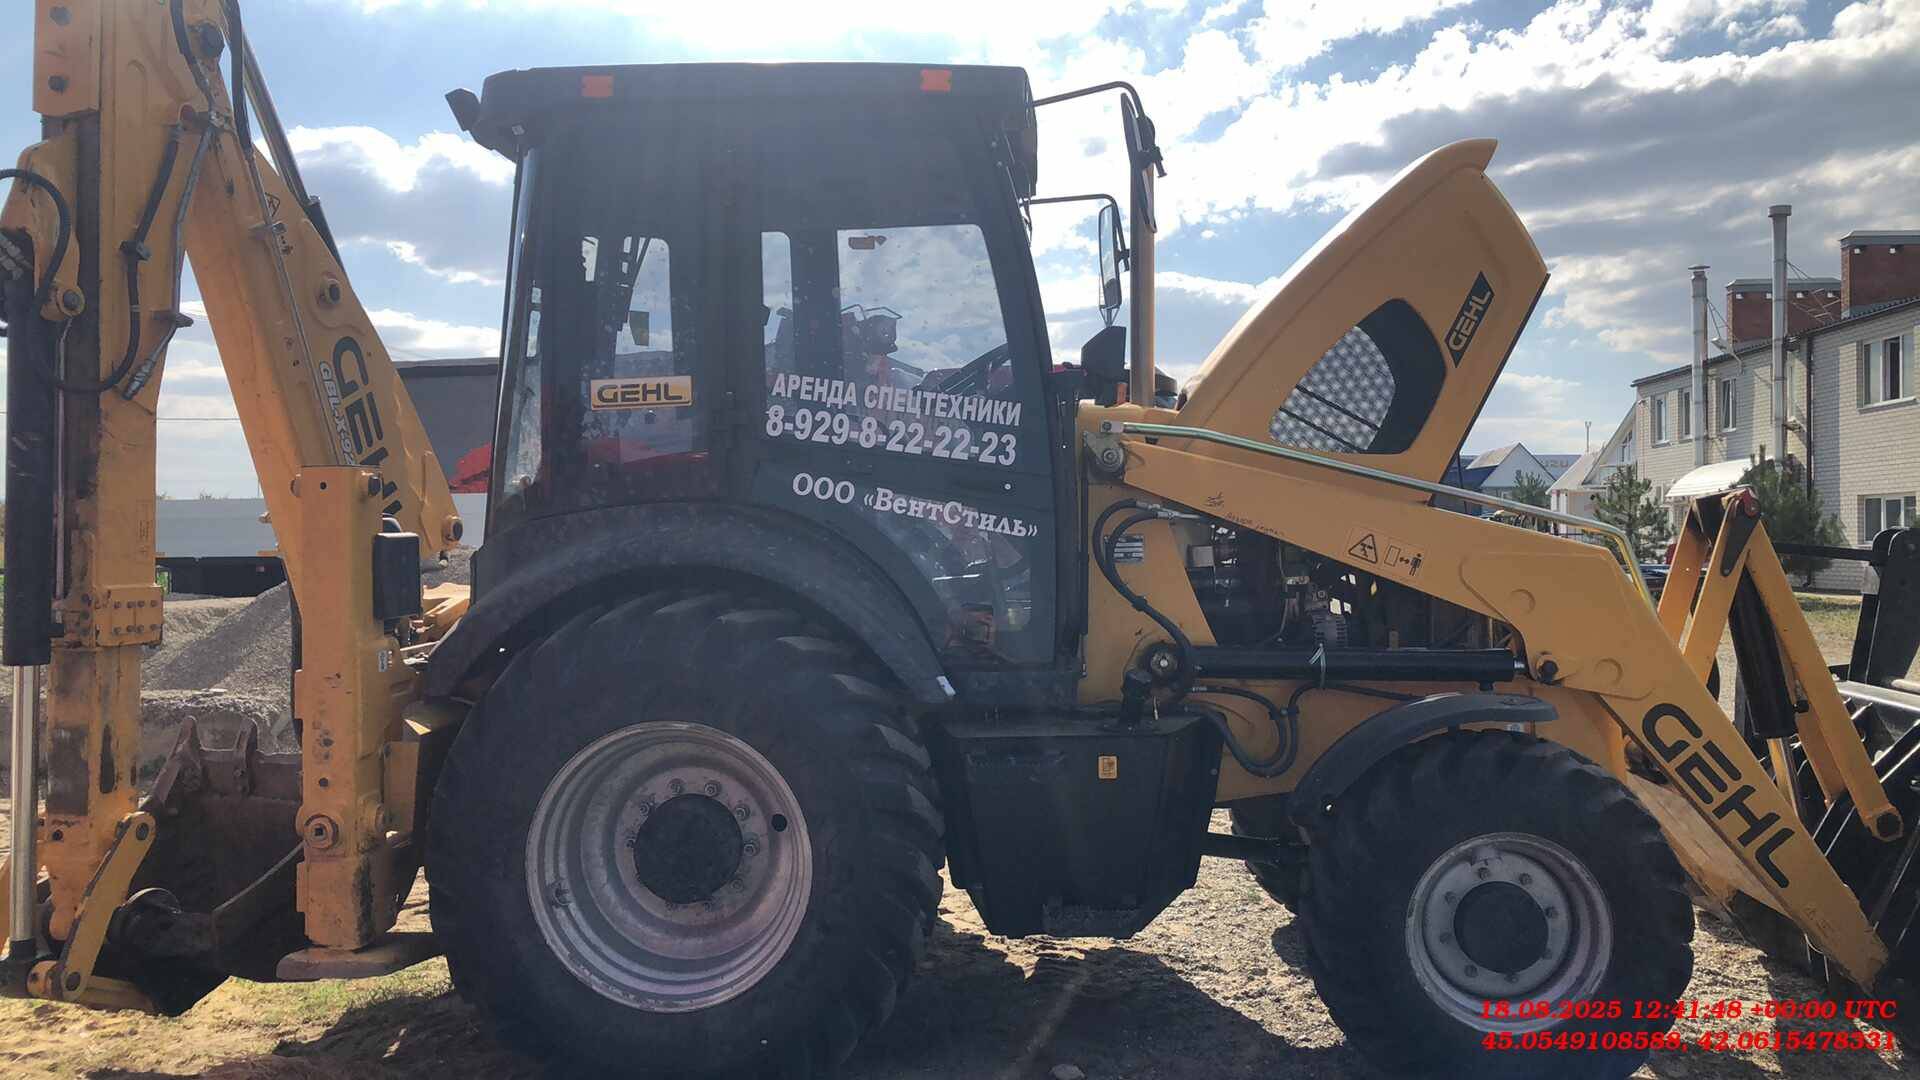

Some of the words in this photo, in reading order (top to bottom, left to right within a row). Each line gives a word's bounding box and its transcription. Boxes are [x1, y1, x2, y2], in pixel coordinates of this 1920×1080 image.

[1448, 290, 1492, 351] GEHL
[597, 382, 682, 403] GEHL
[771, 373, 857, 408] АРЕНДА
[864, 384, 1021, 426] СПЕЦТЕХНИКИ
[766, 405, 1017, 466] 8-929-8-22-22-23
[792, 472, 855, 504] ООО
[863, 487, 1038, 537] «ВентСтиль»
[1642, 703, 1795, 888] GEHL
